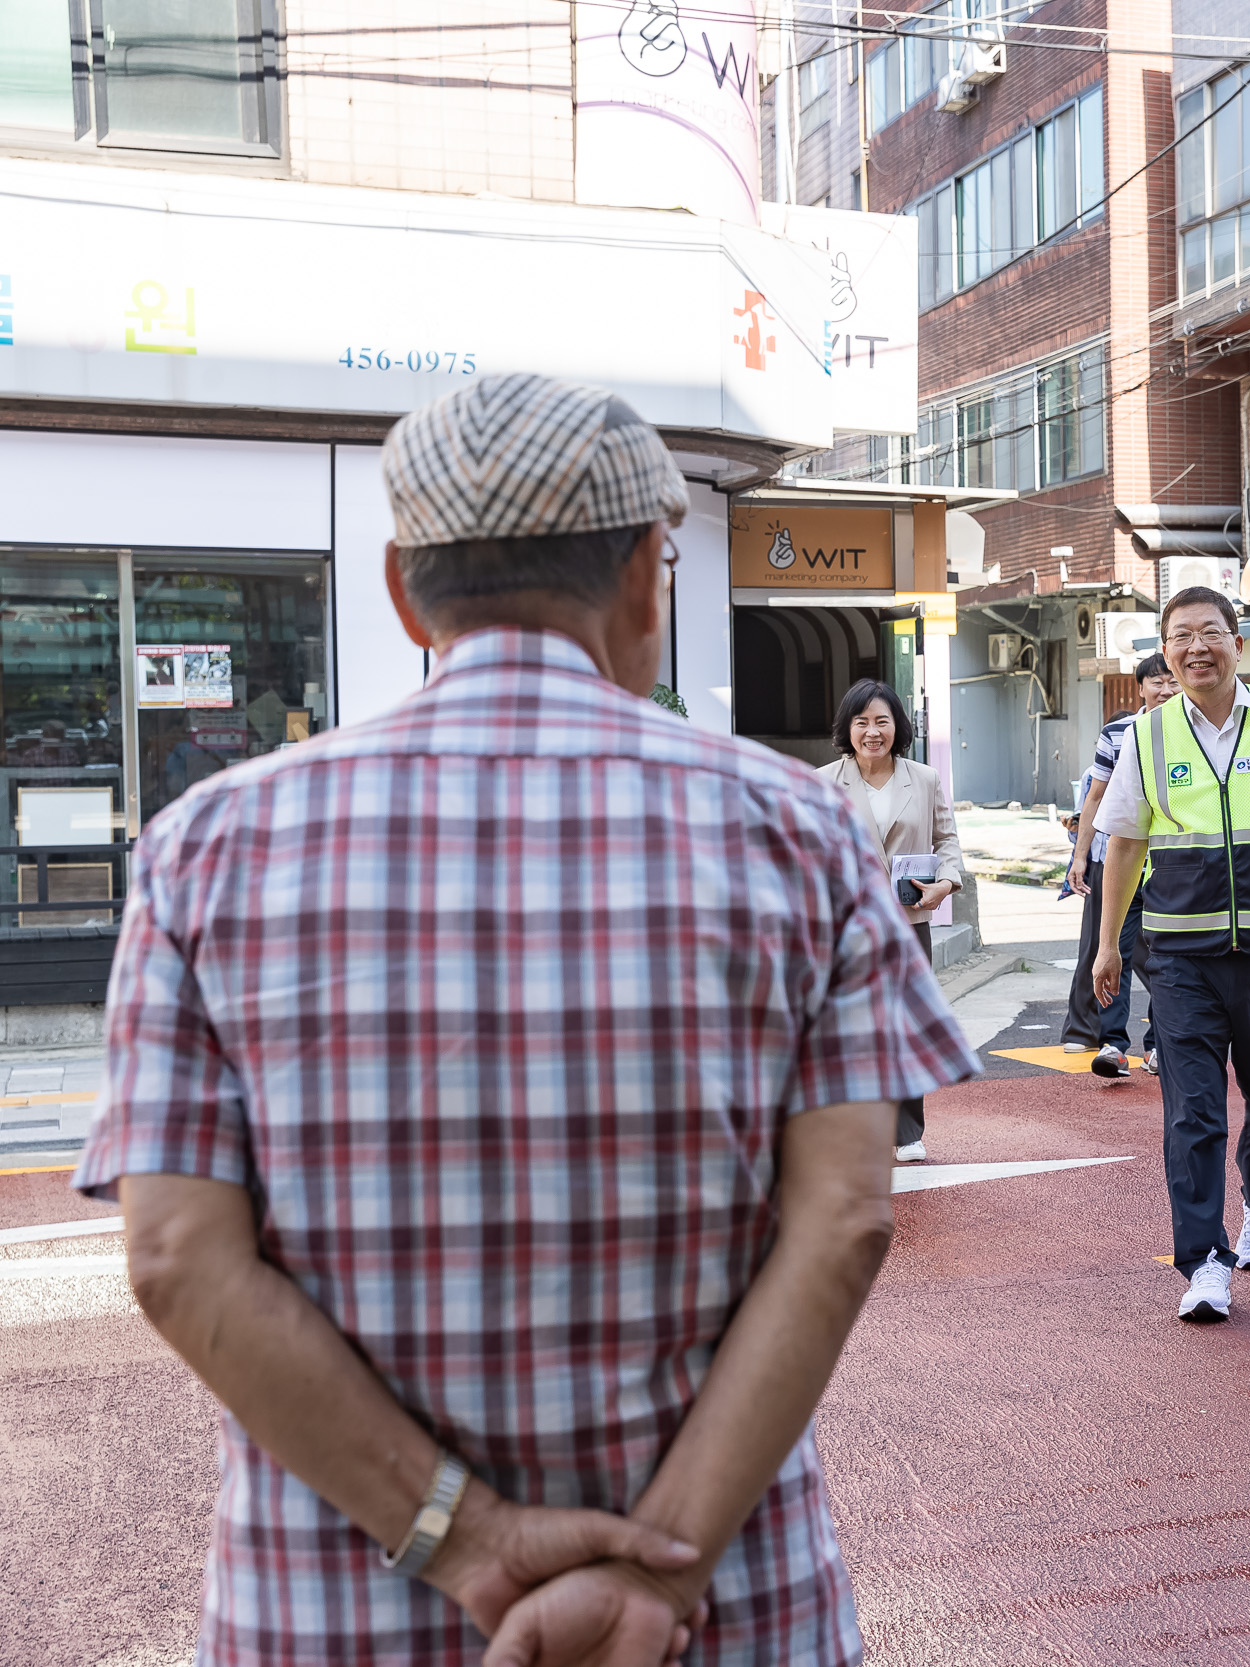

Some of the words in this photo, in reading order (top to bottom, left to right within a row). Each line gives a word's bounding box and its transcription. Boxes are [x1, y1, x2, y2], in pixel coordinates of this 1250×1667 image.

[124, 280, 198, 355] 원
[338, 346, 476, 376] 456-0975
[831, 333, 889, 369] IT
[802, 547, 867, 570] WIT
[764, 573, 817, 583] marketing
[819, 574, 869, 584] company
